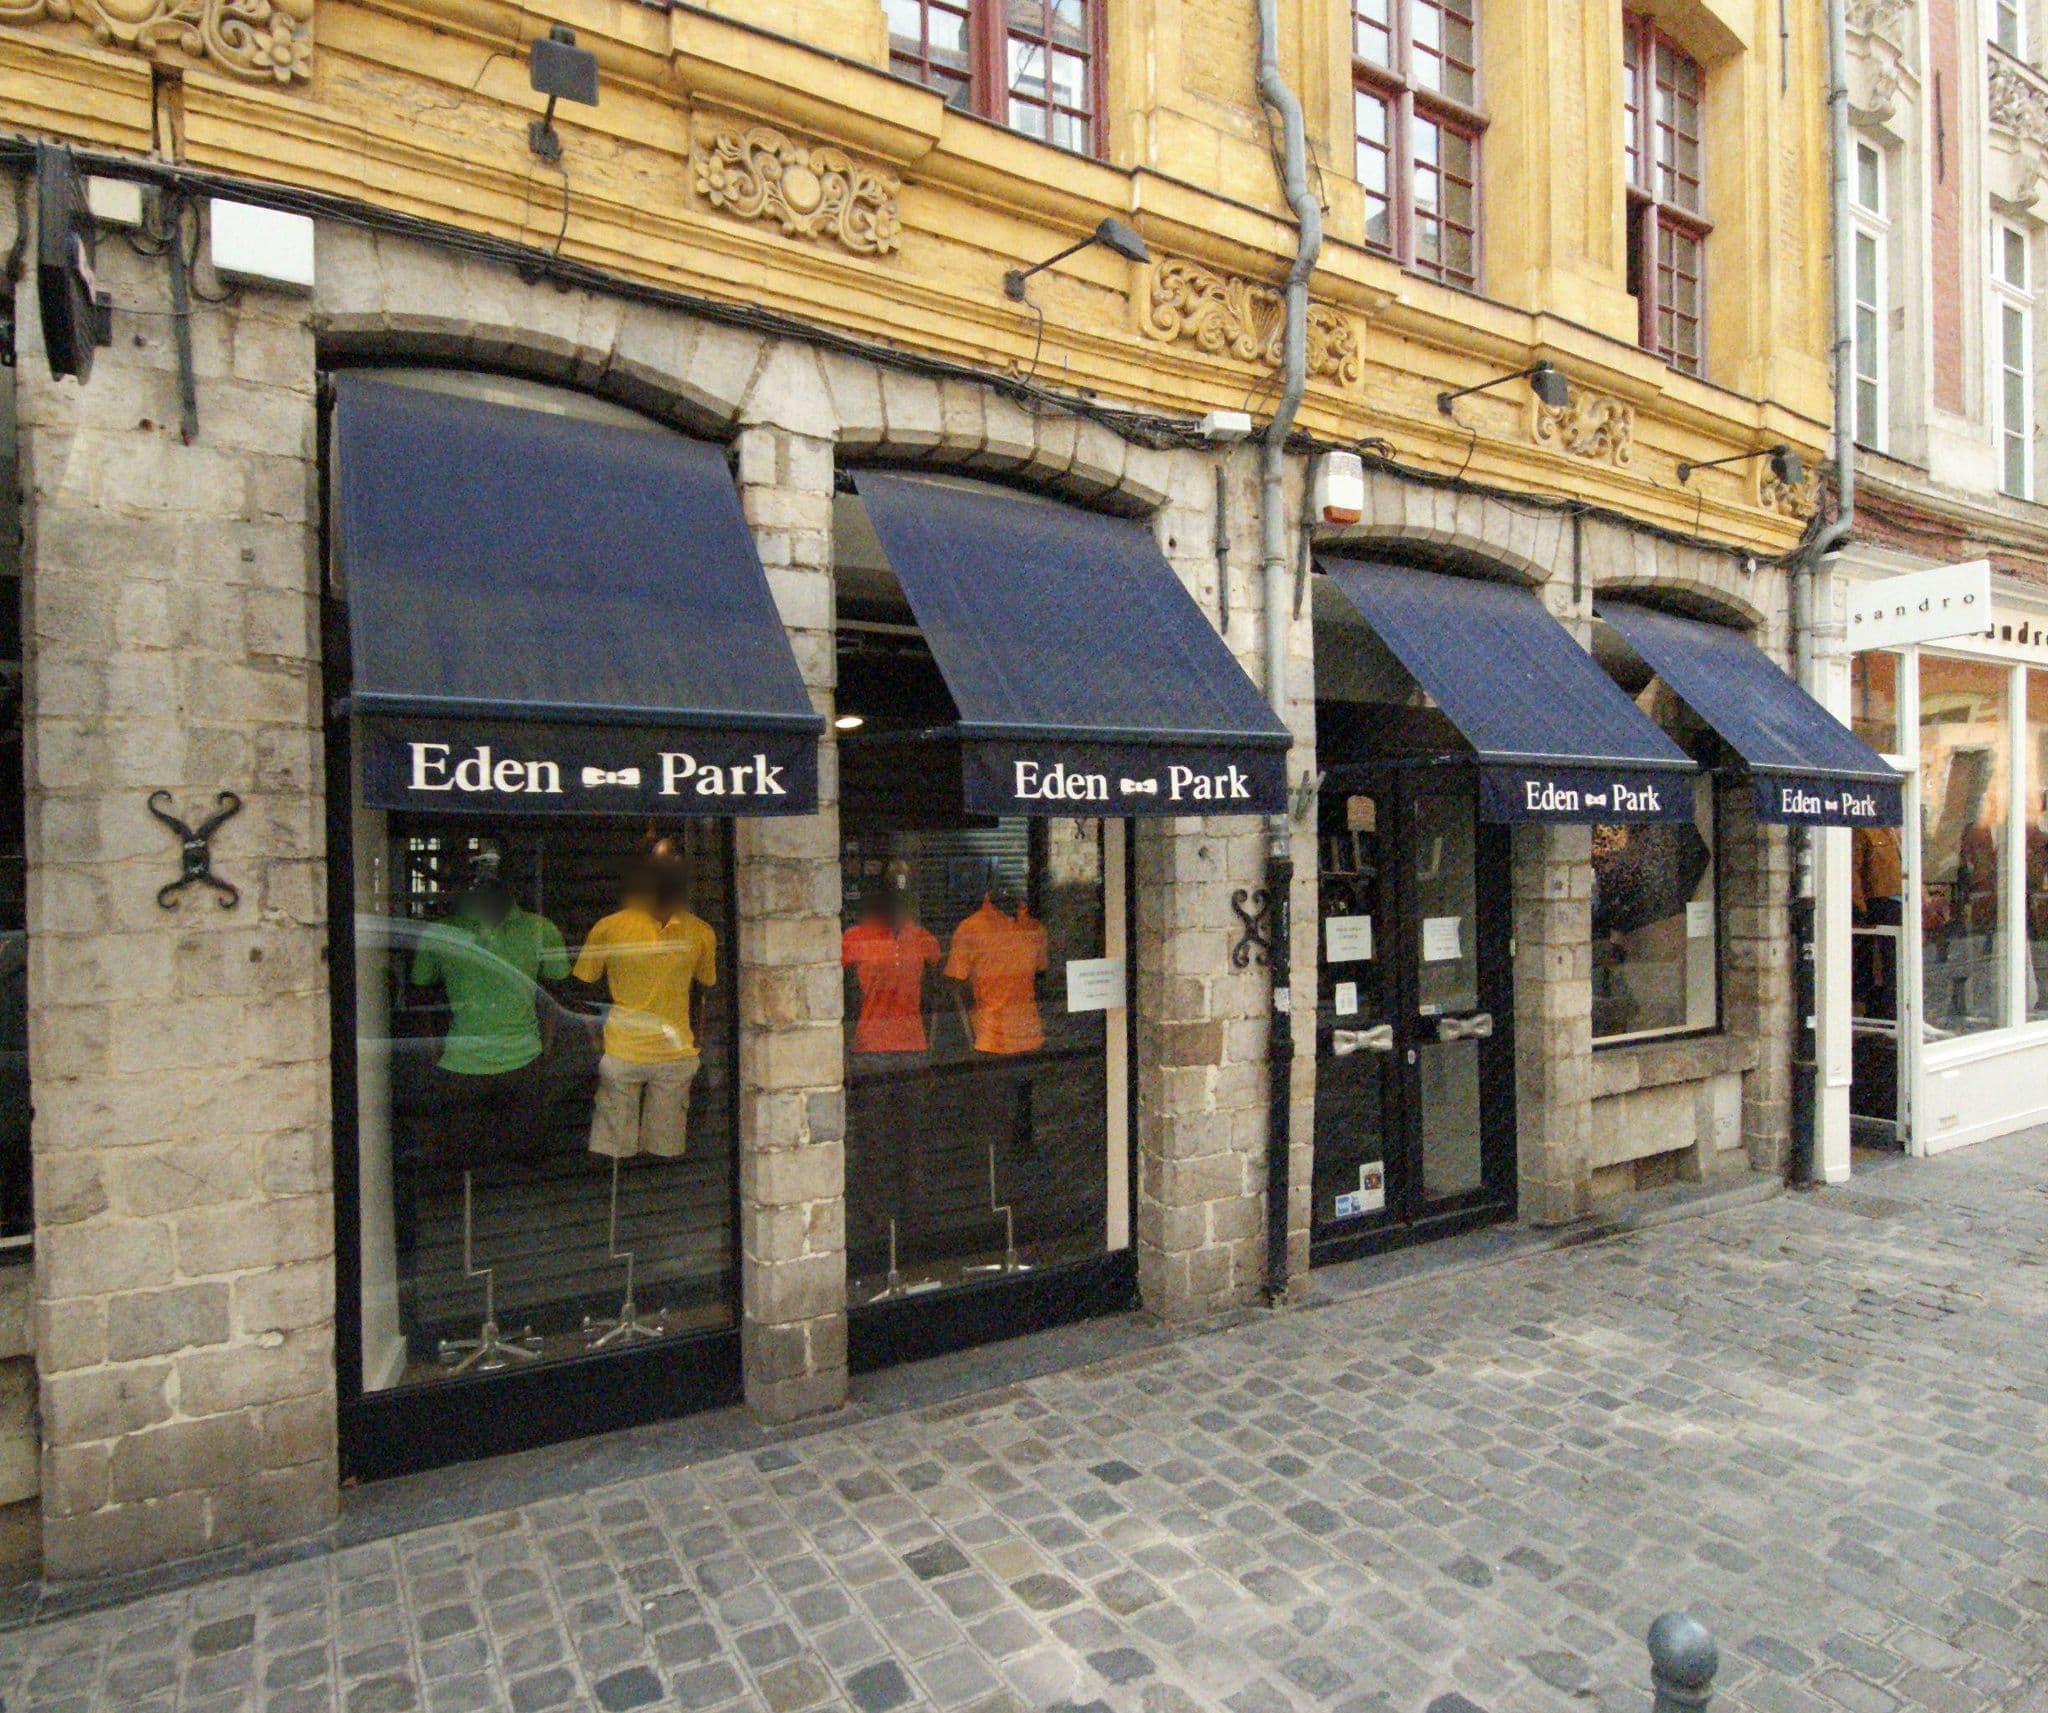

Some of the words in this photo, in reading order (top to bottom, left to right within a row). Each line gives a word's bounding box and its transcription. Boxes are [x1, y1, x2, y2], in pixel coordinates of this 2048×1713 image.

[1854, 593, 1975, 623] sandro
[407, 742, 563, 793] Eden
[658, 752, 787, 796] Park
[1014, 760, 1109, 799] Eden
[1168, 765, 1251, 801] Park
[1526, 781, 1580, 811] Eden
[1612, 783, 1661, 811] Park
[1781, 788, 1822, 815] Eden
[1841, 792, 1877, 816] Park
